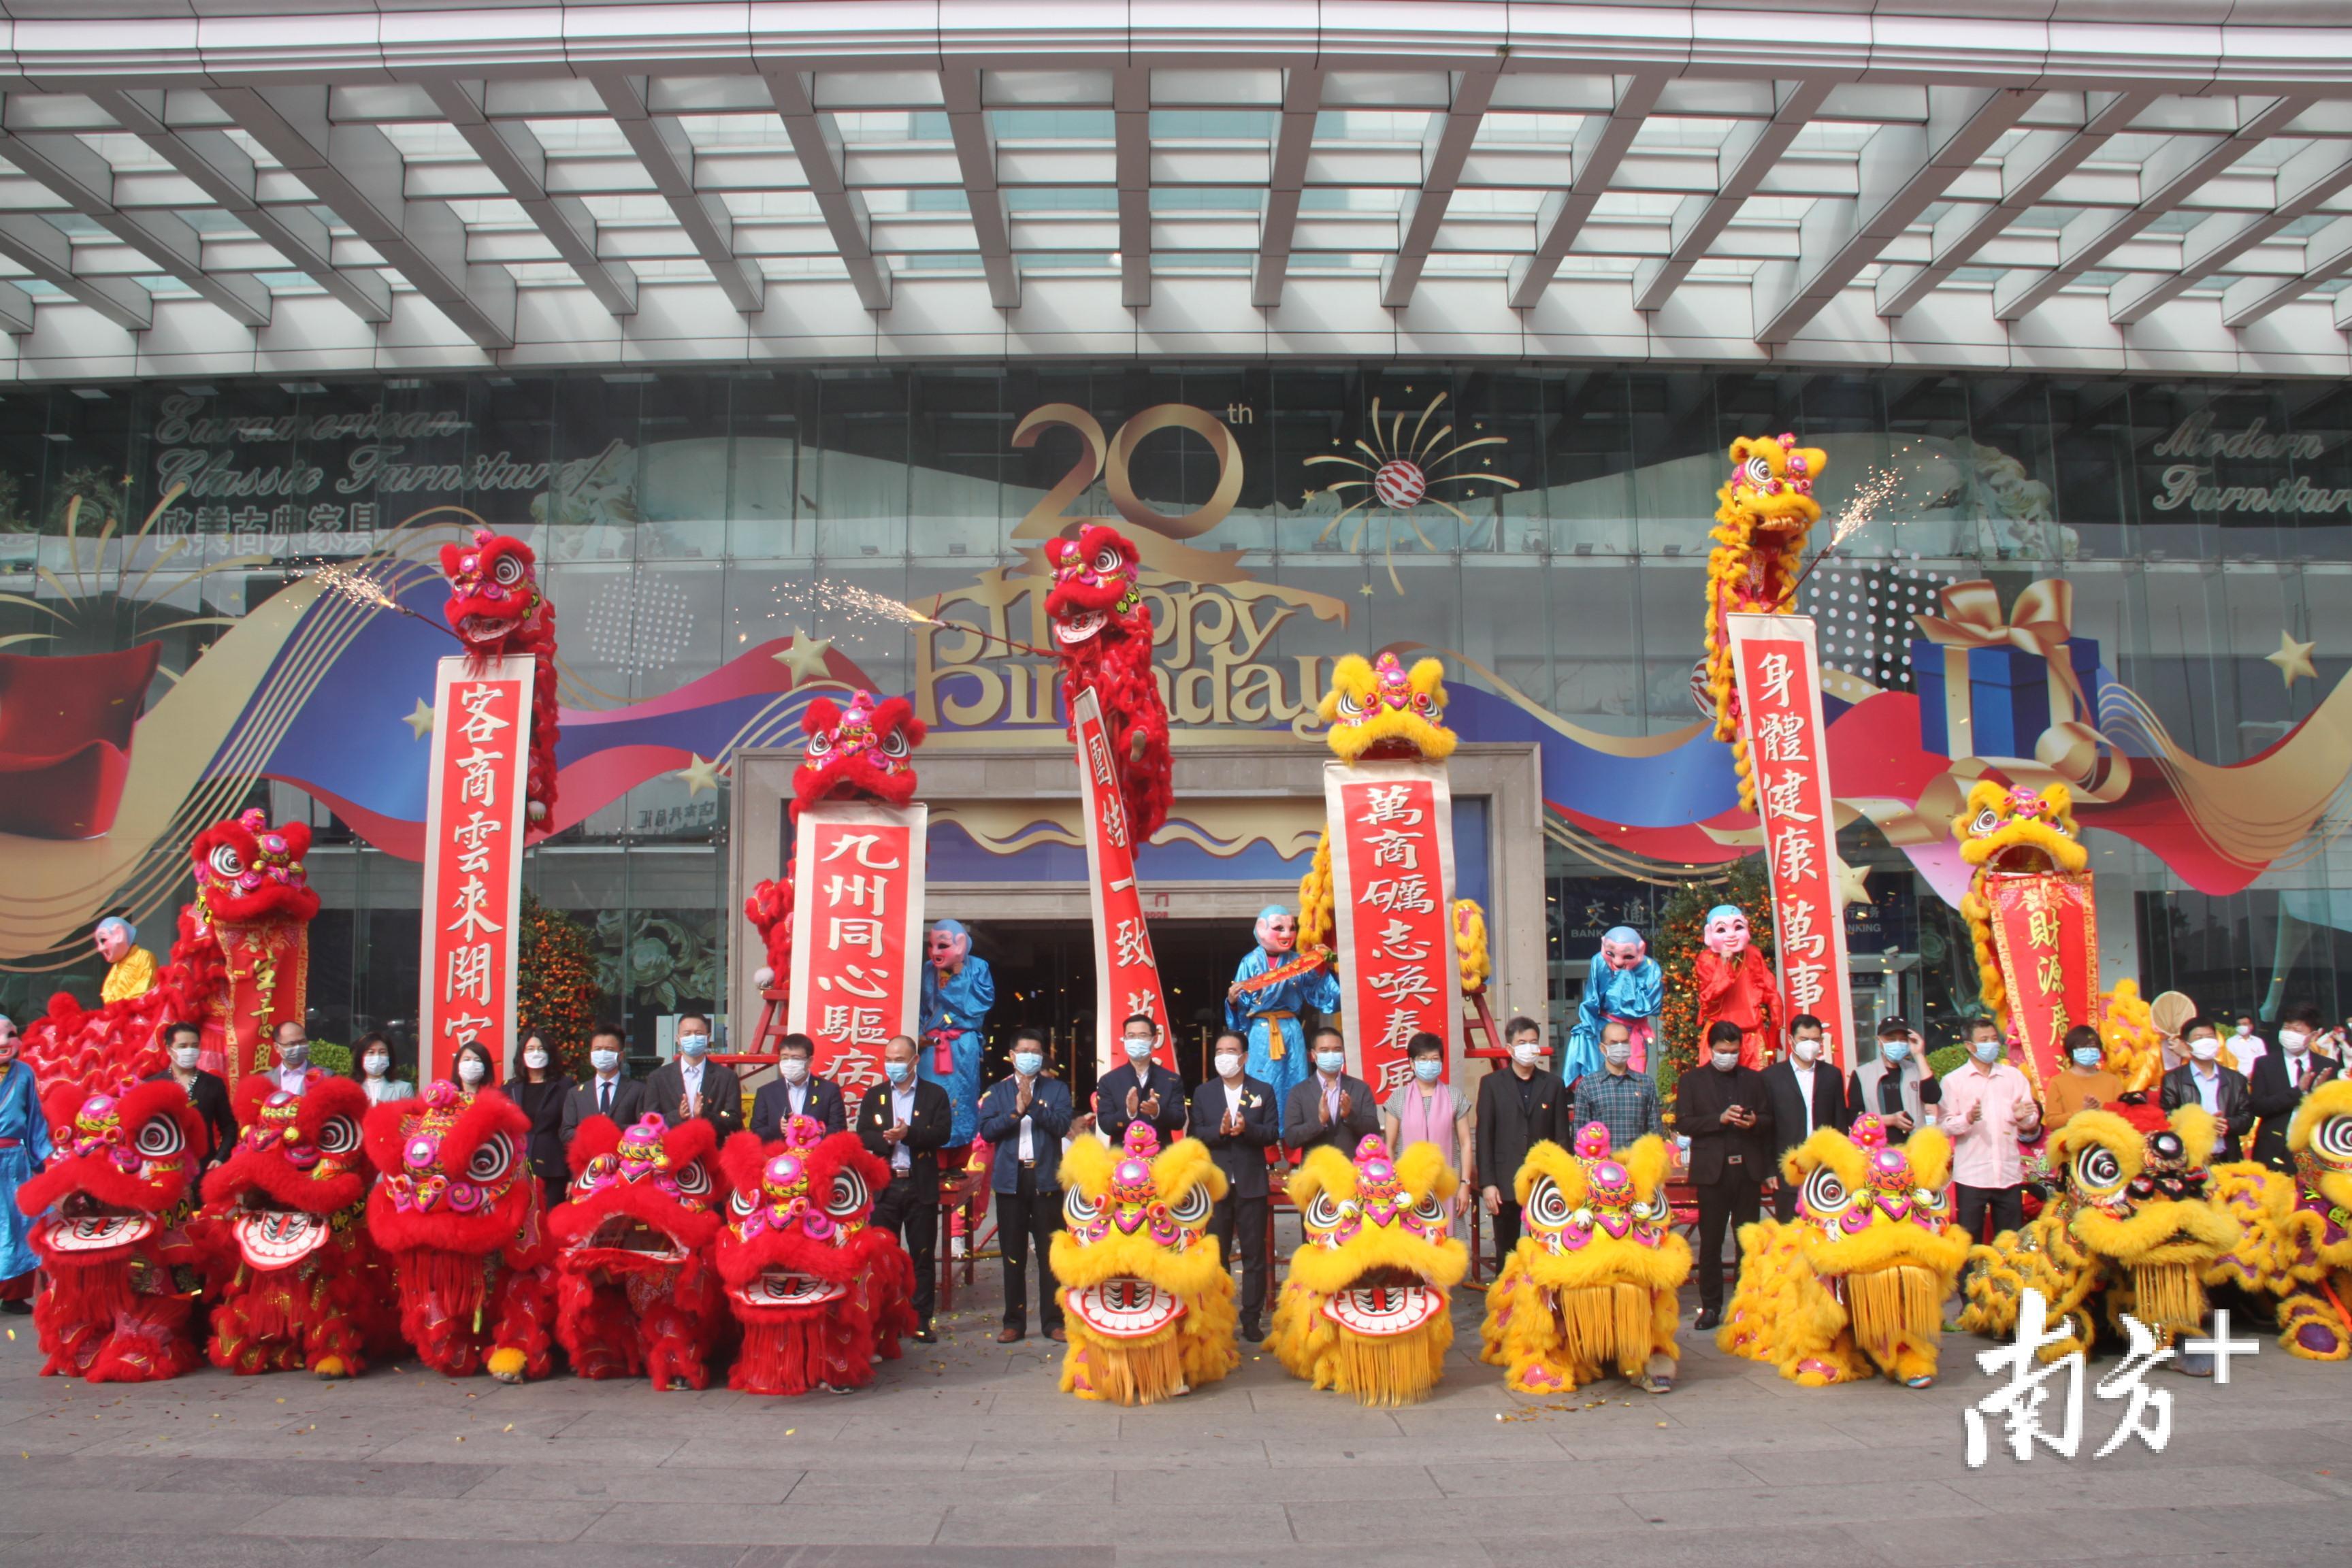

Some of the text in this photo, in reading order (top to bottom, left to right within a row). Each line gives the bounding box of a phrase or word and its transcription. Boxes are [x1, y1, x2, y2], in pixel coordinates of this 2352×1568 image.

[2153, 409, 2324, 459] Modern
[157, 448, 324, 497] Classic
[2153, 464, 2352, 512] Furnitur
[156, 504, 380, 555] 欧美古典家具
[1758, 653, 1832, 1064] 身體健康萬事
[1089, 734, 1164, 1066] 團結一致
[1583, 897, 1672, 927] 交通
[1846, 924, 1882, 932] NKING
